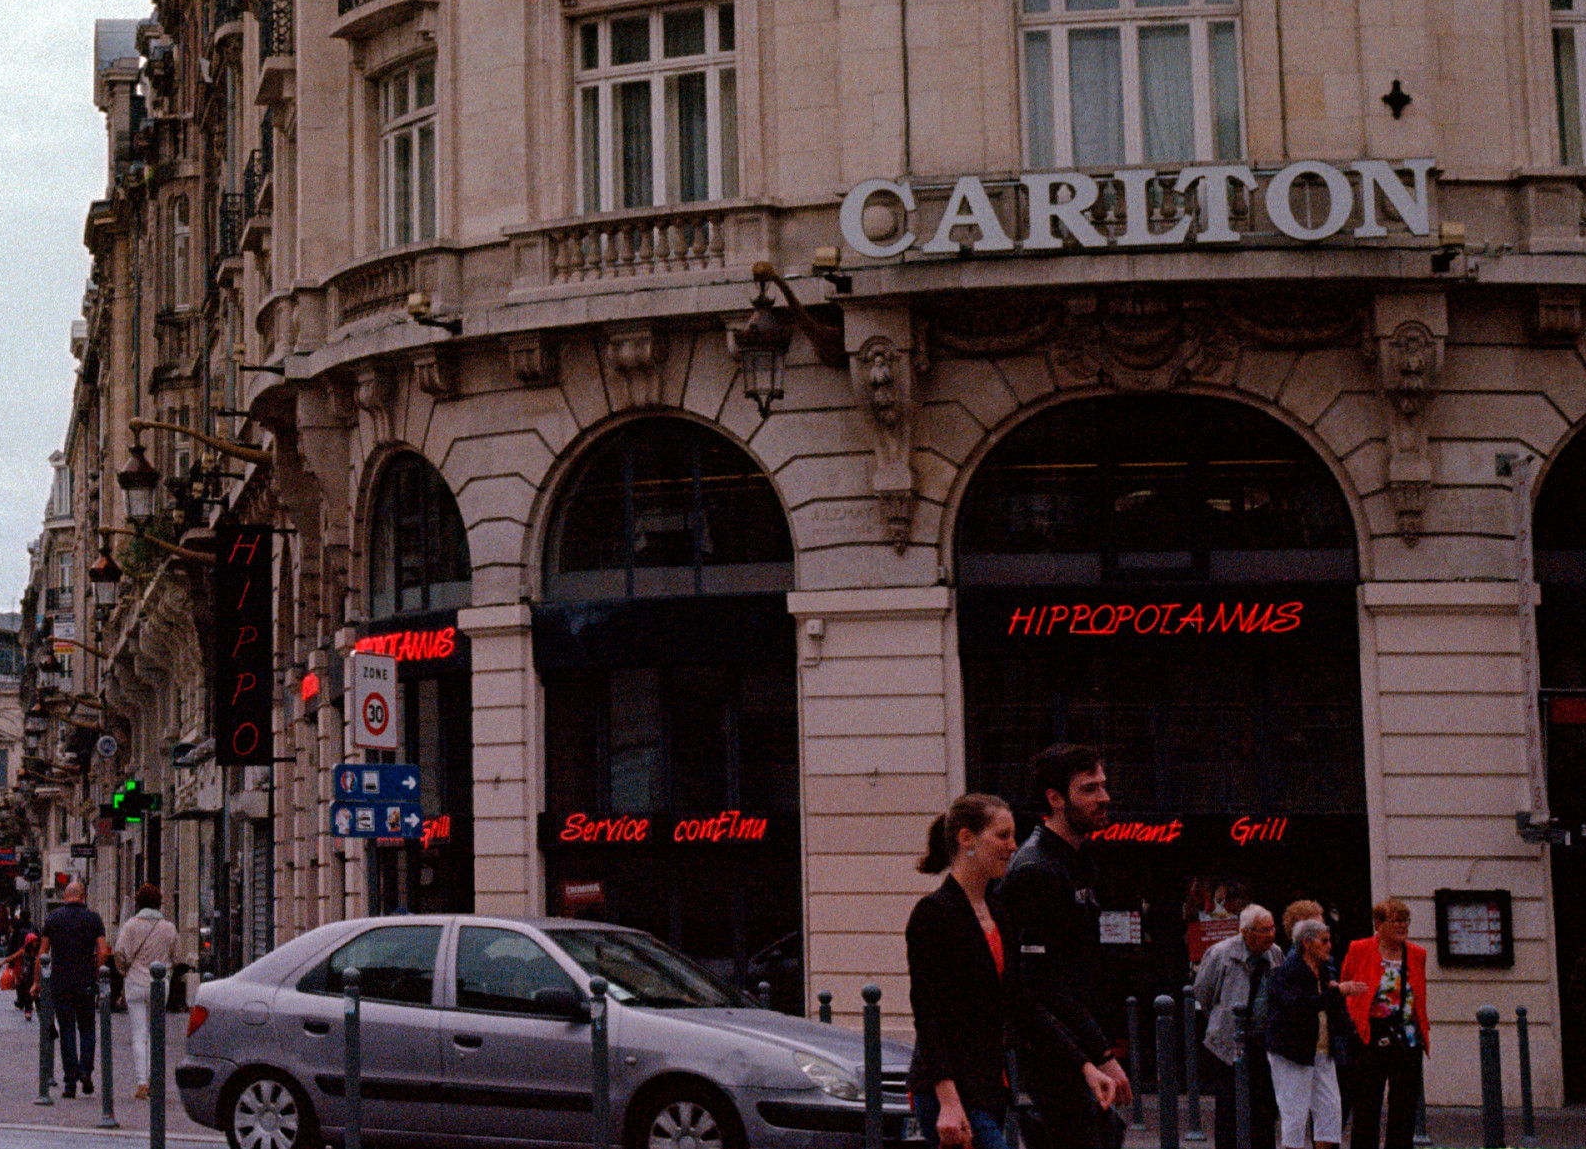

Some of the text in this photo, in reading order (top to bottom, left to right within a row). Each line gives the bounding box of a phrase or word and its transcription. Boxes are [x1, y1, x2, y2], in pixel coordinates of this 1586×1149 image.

[839, 158, 1436, 258] CARLTON
[1008, 601, 1304, 636] HIPPOPOTAMUS
[227, 533, 261, 756] HIPPO
[363, 666, 388, 680] ZONE
[368, 705, 383, 723] 30
[560, 812, 650, 842] Service
[1230, 815, 1289, 846] Grill
